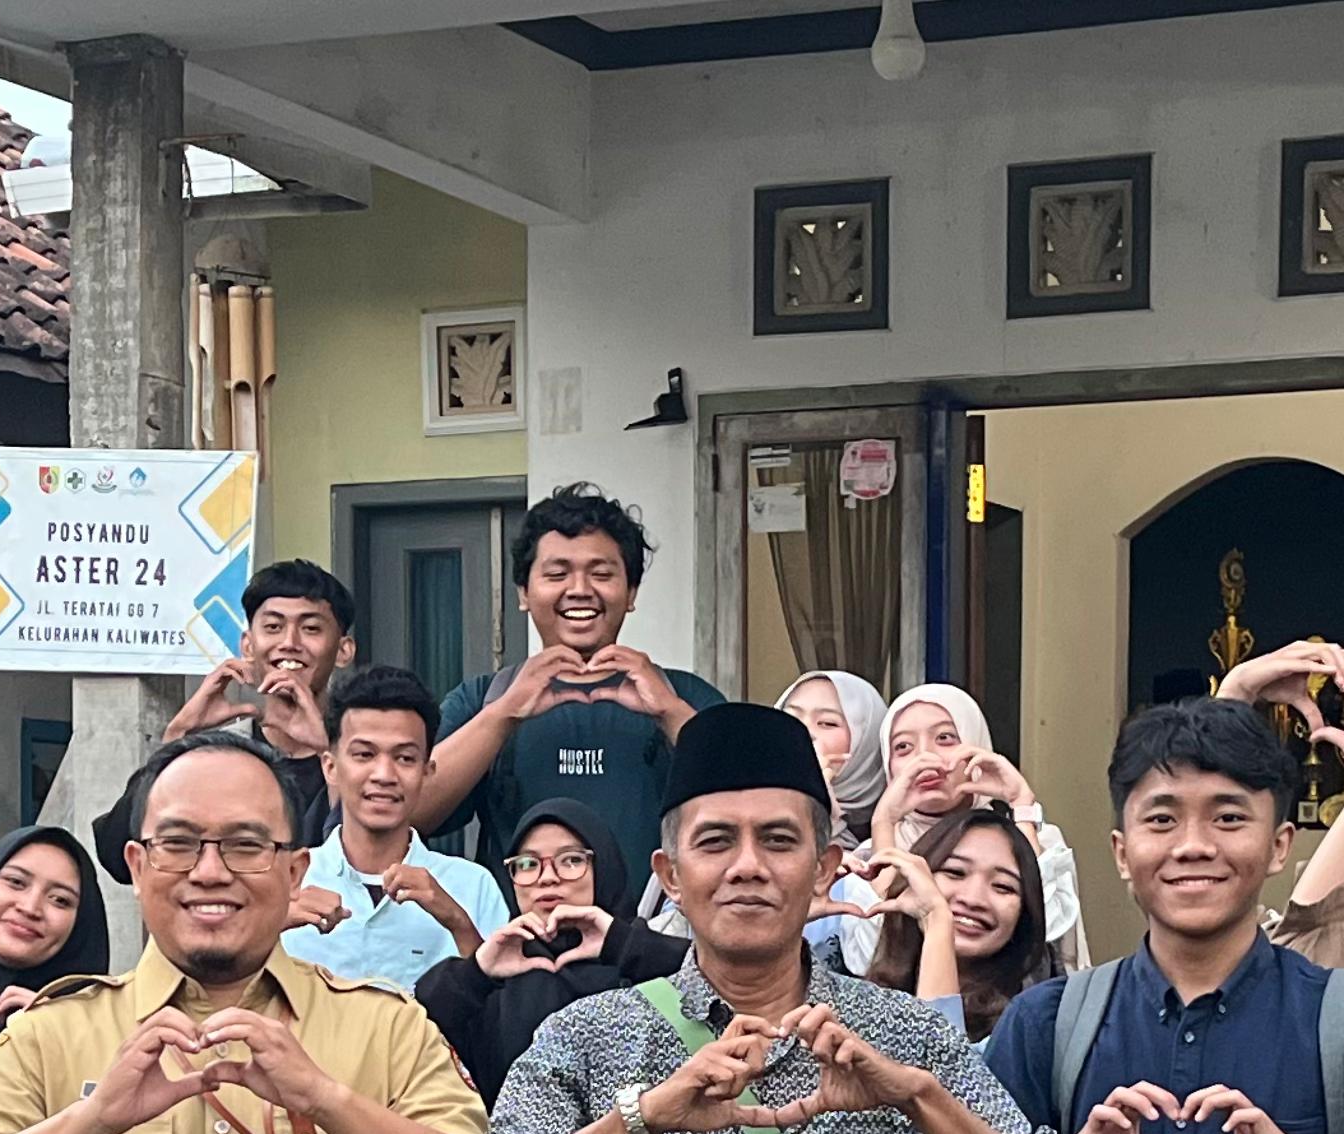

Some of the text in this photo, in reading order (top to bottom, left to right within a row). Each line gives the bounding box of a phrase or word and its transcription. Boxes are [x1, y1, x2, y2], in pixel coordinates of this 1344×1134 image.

[47, 522, 150, 545] POSYANDU
[36, 555, 167, 586] ASTER 24
[63, 601, 120, 617] TERATAI
[127, 603, 144, 618] GG
[152, 603, 160, 618] 7
[18, 625, 186, 645] KELURAHAN KALIWATES
[559, 748, 604, 775] HUSTLE
